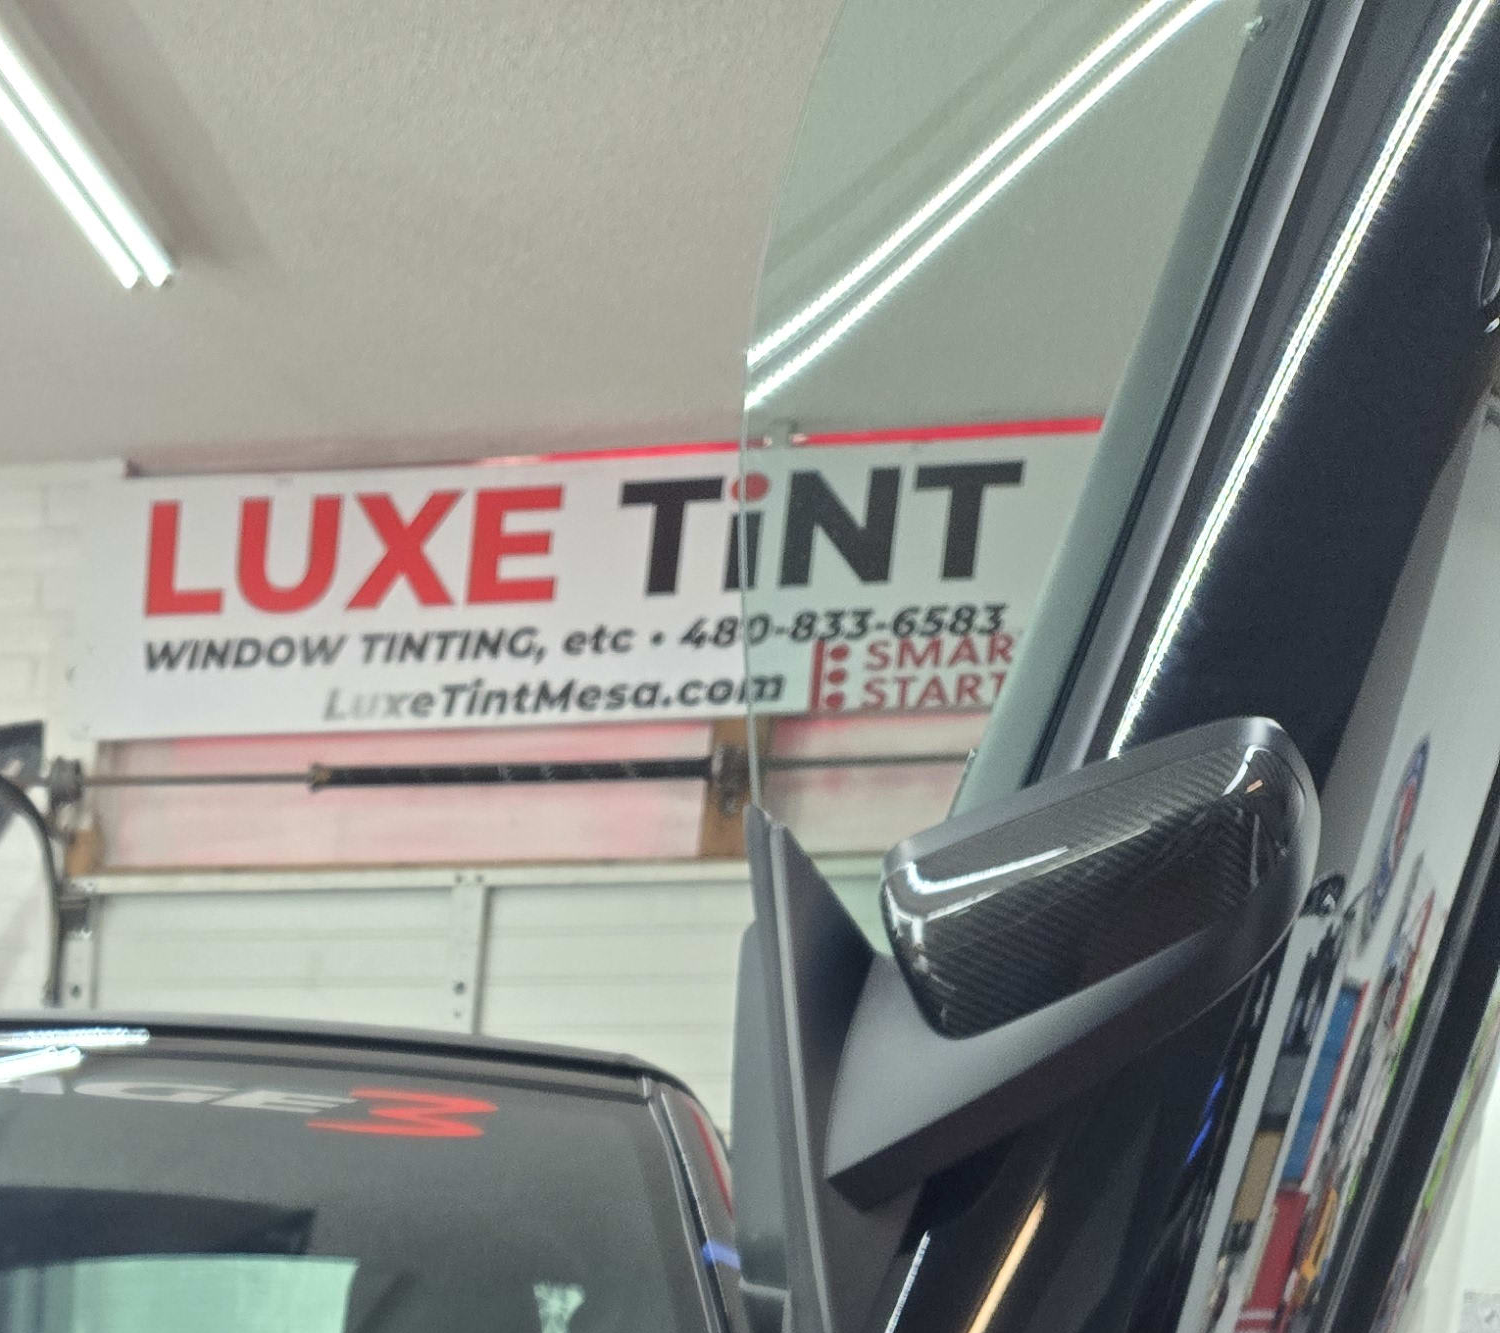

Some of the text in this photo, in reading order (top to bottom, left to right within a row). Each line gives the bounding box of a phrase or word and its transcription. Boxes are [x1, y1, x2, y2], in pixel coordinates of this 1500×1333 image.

[144, 485, 564, 617] LUXE
[145, 602, 1008, 671] WINDOW TINTING, etc 480-833-6583
[864, 632, 1016, 671] SMAR
[322, 673, 785, 721] LuxeTintMesa.com
